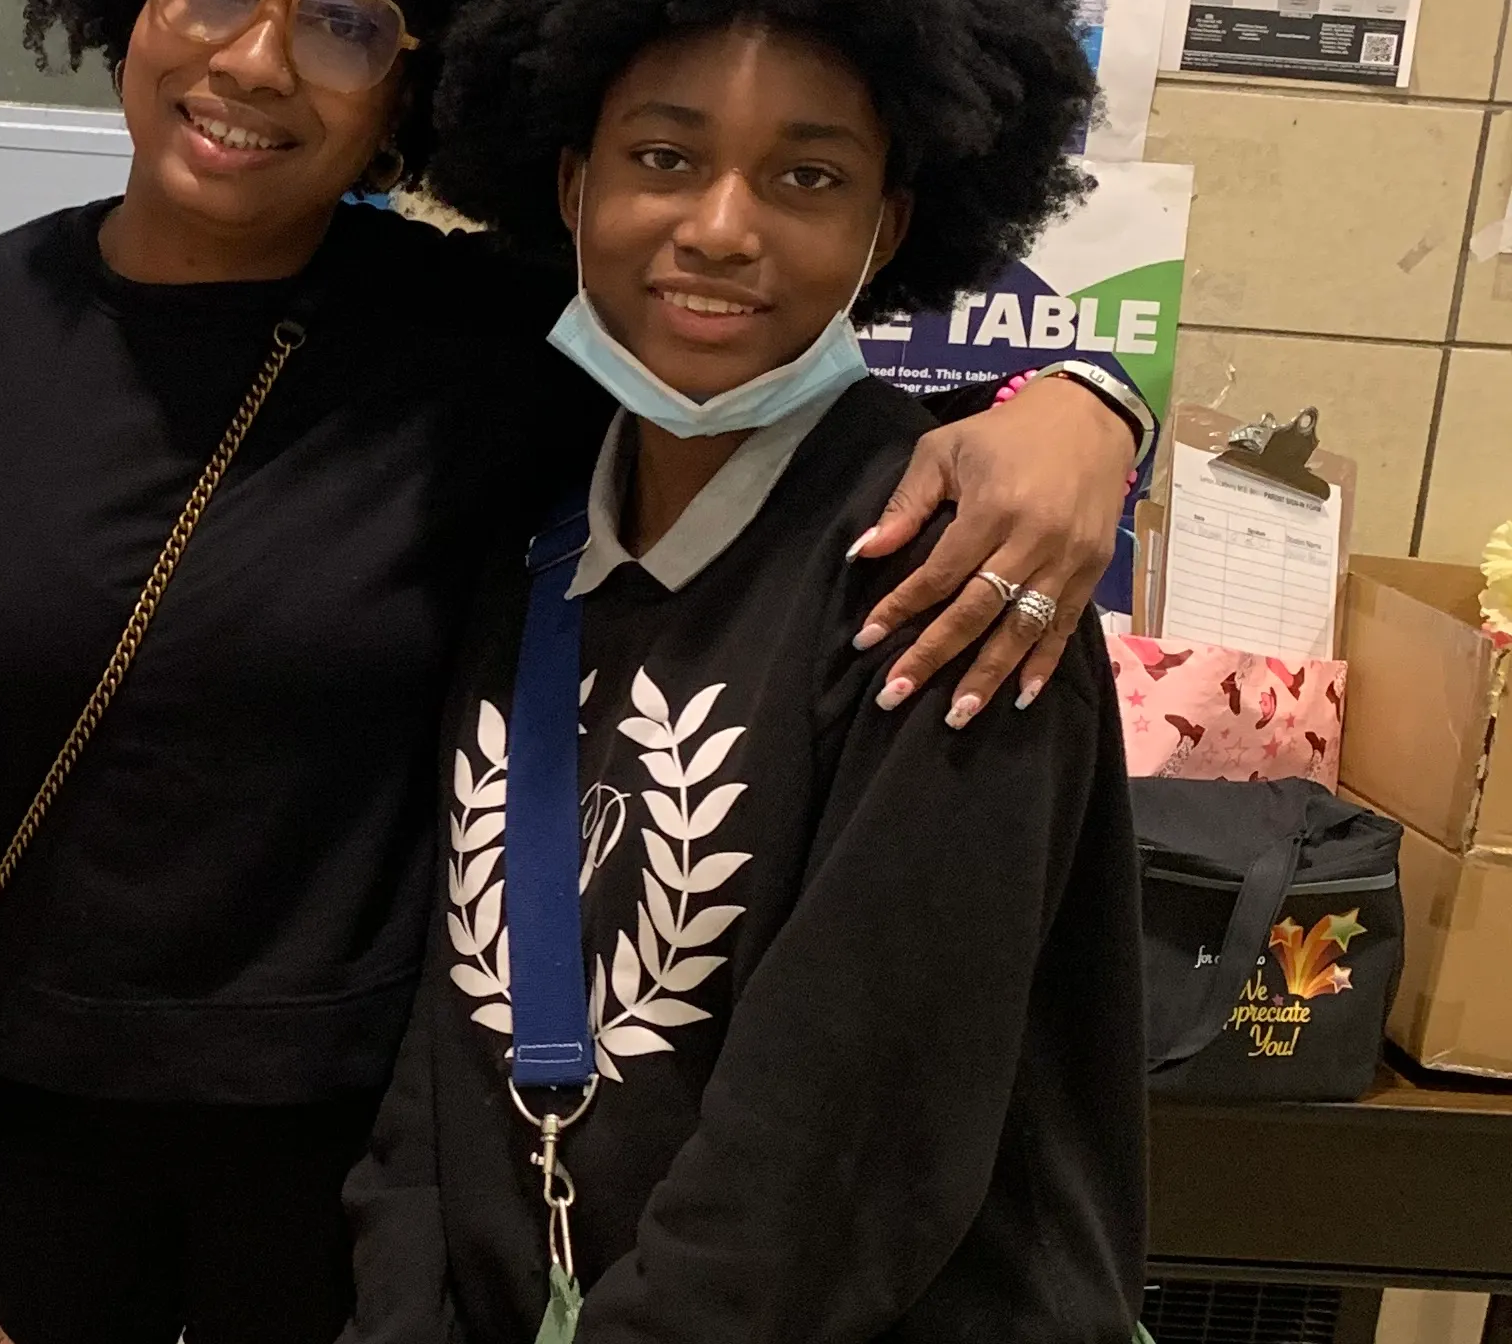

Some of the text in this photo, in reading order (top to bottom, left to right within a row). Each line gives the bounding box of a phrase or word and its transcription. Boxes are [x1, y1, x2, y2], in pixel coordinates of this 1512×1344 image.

[948, 290, 1160, 354] TABLE
[898, 366, 932, 379] food.
[935, 368, 962, 381] This
[965, 370, 999, 382] table
[1223, 1000, 1311, 1030] ppreciate
[1248, 1024, 1301, 1056] You!
